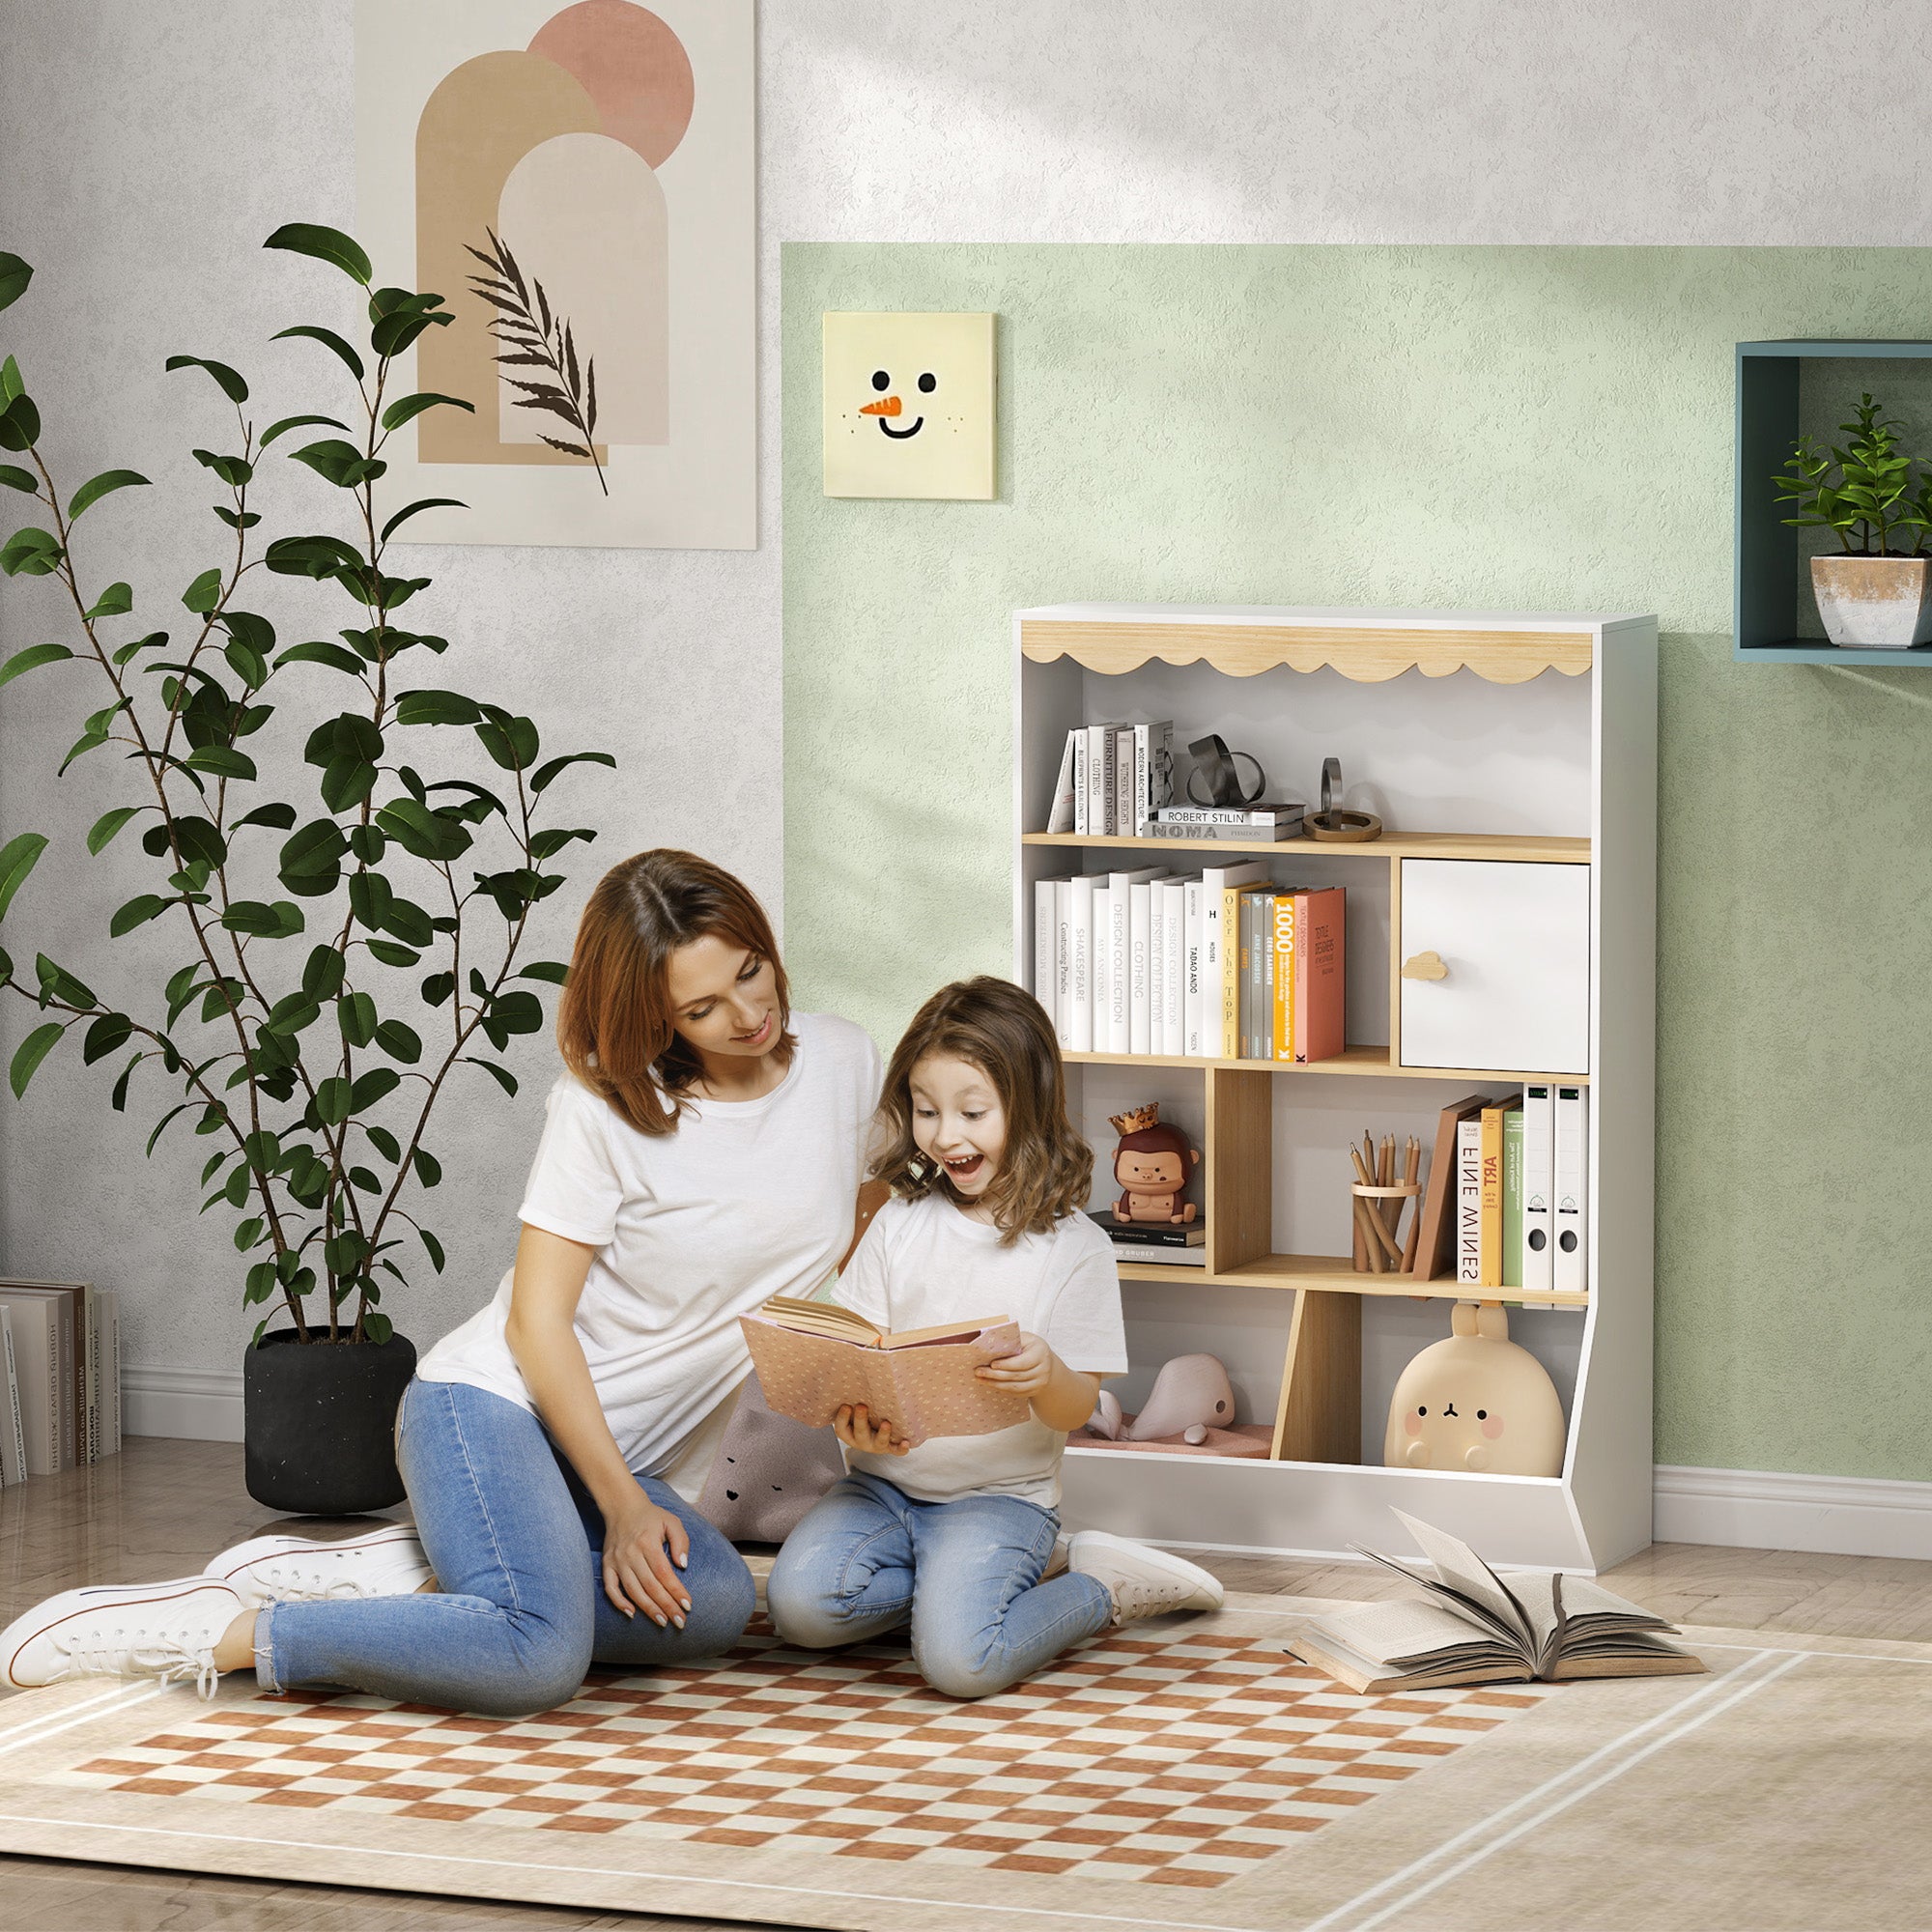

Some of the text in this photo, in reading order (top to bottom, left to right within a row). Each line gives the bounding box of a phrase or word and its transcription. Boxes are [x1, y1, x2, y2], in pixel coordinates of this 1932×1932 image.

[1121, 762, 1129, 825] WUTHERING HEIGHTS
[1168, 812, 1244, 823] ROBERT STILIN
[1151, 825, 1218, 838] NOMA
[1060, 923, 1068, 965] Constructing
[1276, 903, 1293, 953] 1000
[1076, 928, 1085, 1002] SHAKESPEARE
[1113, 903, 1123, 1024] DESIGN COLLECTION
[1134, 941, 1144, 999] CLOTHING
[1151, 914, 1162, 1023] DESIGN COLLECTION
